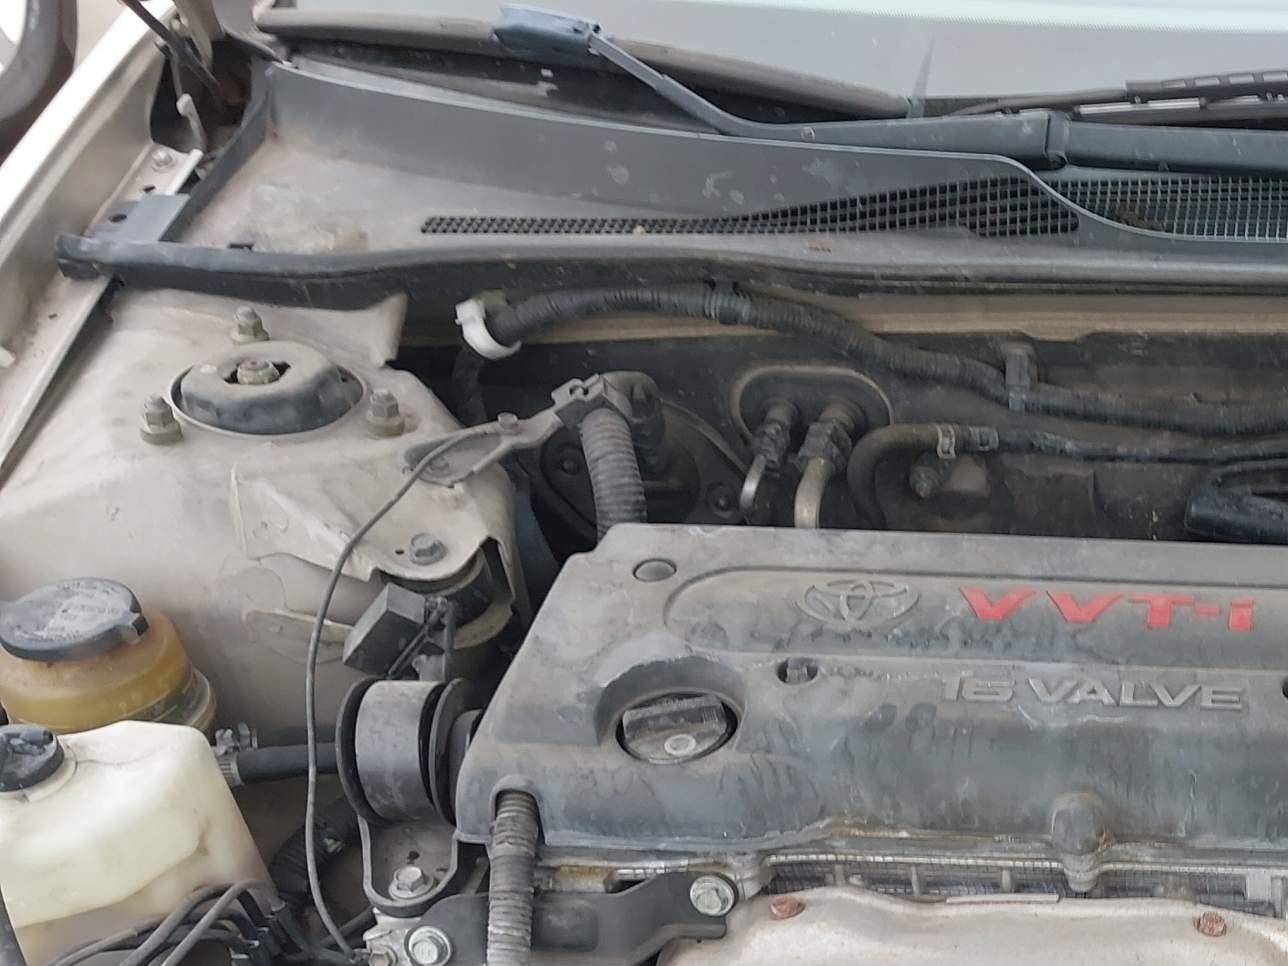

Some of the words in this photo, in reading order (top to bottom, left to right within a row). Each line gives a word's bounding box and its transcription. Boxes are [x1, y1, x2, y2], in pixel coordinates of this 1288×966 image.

[961, 584, 1255, 632] VVT-i
[941, 675, 1016, 705] 16
[1029, 677, 1245, 711] VALVE
